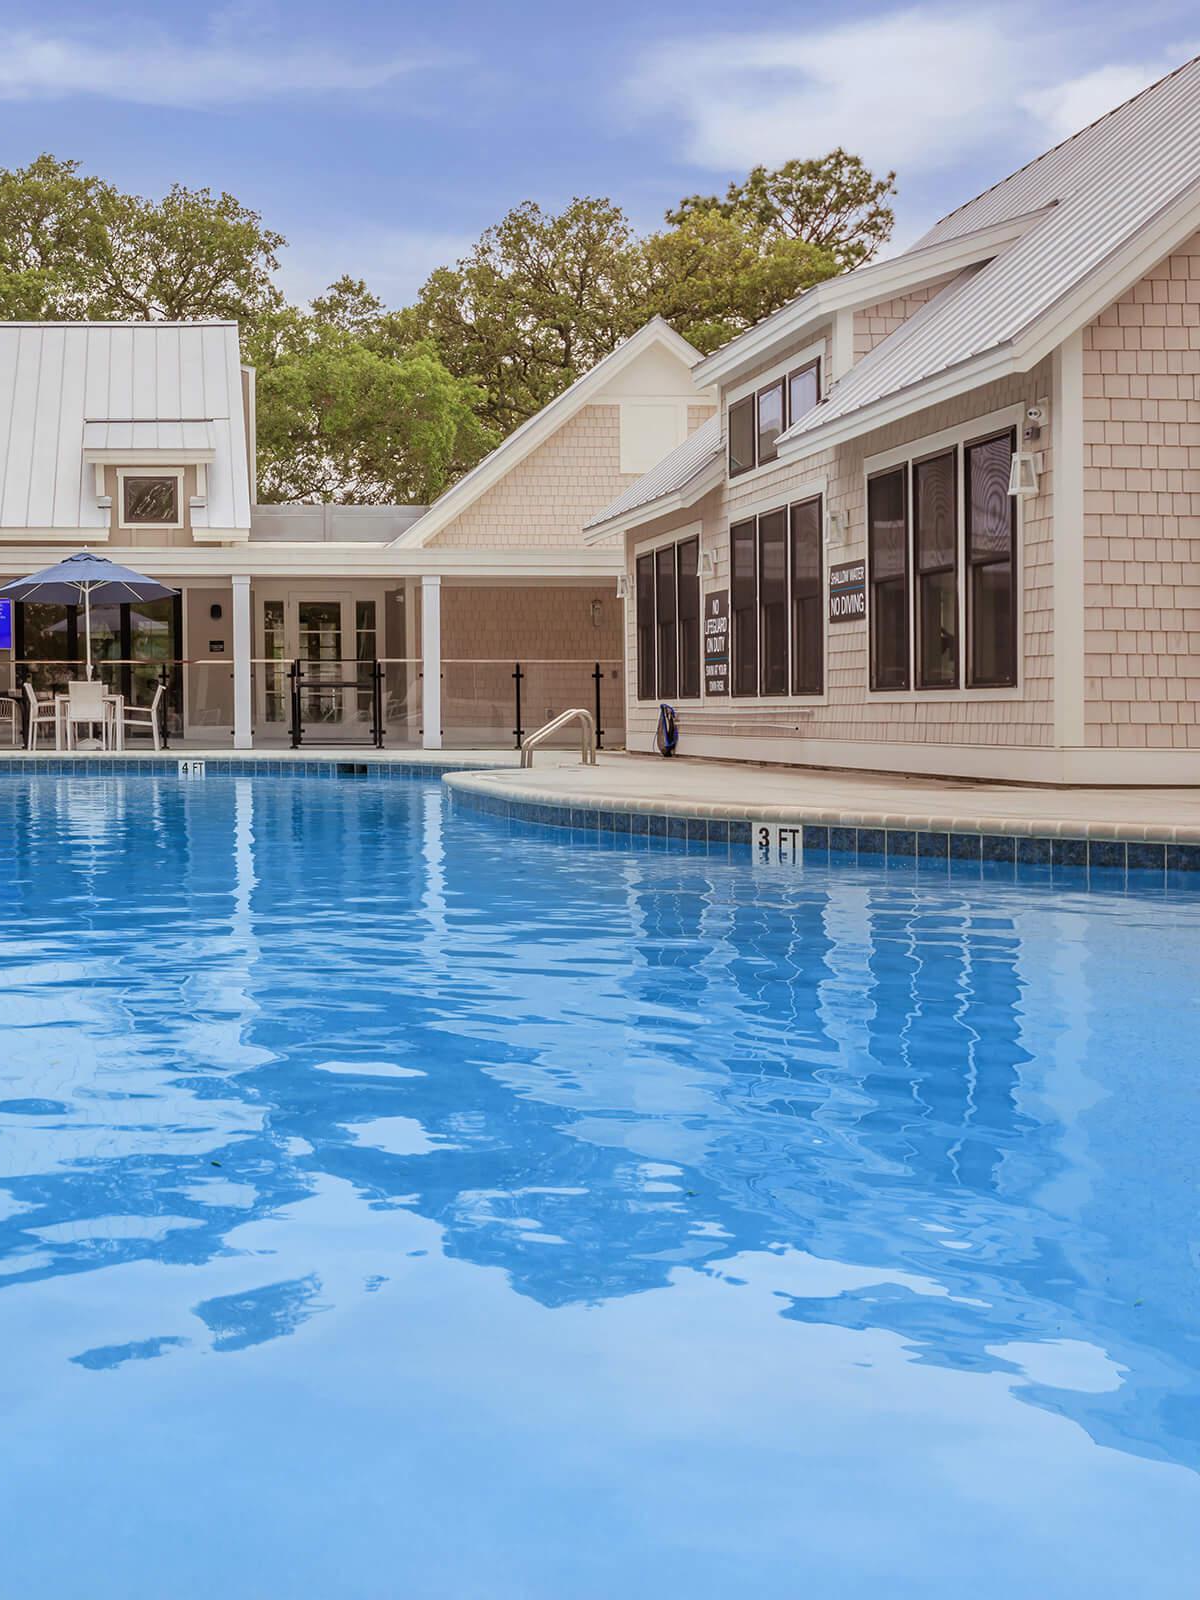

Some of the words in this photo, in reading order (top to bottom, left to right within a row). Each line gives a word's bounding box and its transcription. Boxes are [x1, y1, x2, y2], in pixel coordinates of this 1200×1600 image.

[831, 570, 849, 585] SHALLOW
[849, 566, 865, 581] WATER
[712, 599, 720, 615] NO
[830, 597, 840, 616] NO
[841, 593, 865, 615] DIVING
[704, 616, 728, 635] LIFEGUARD
[706, 637, 714, 653] ON
[714, 636, 725, 652] DUTY
[182, 762, 188, 773] 4
[193, 762, 203, 776] FT
[759, 827, 769, 847] 3
[779, 828, 800, 848] FT
